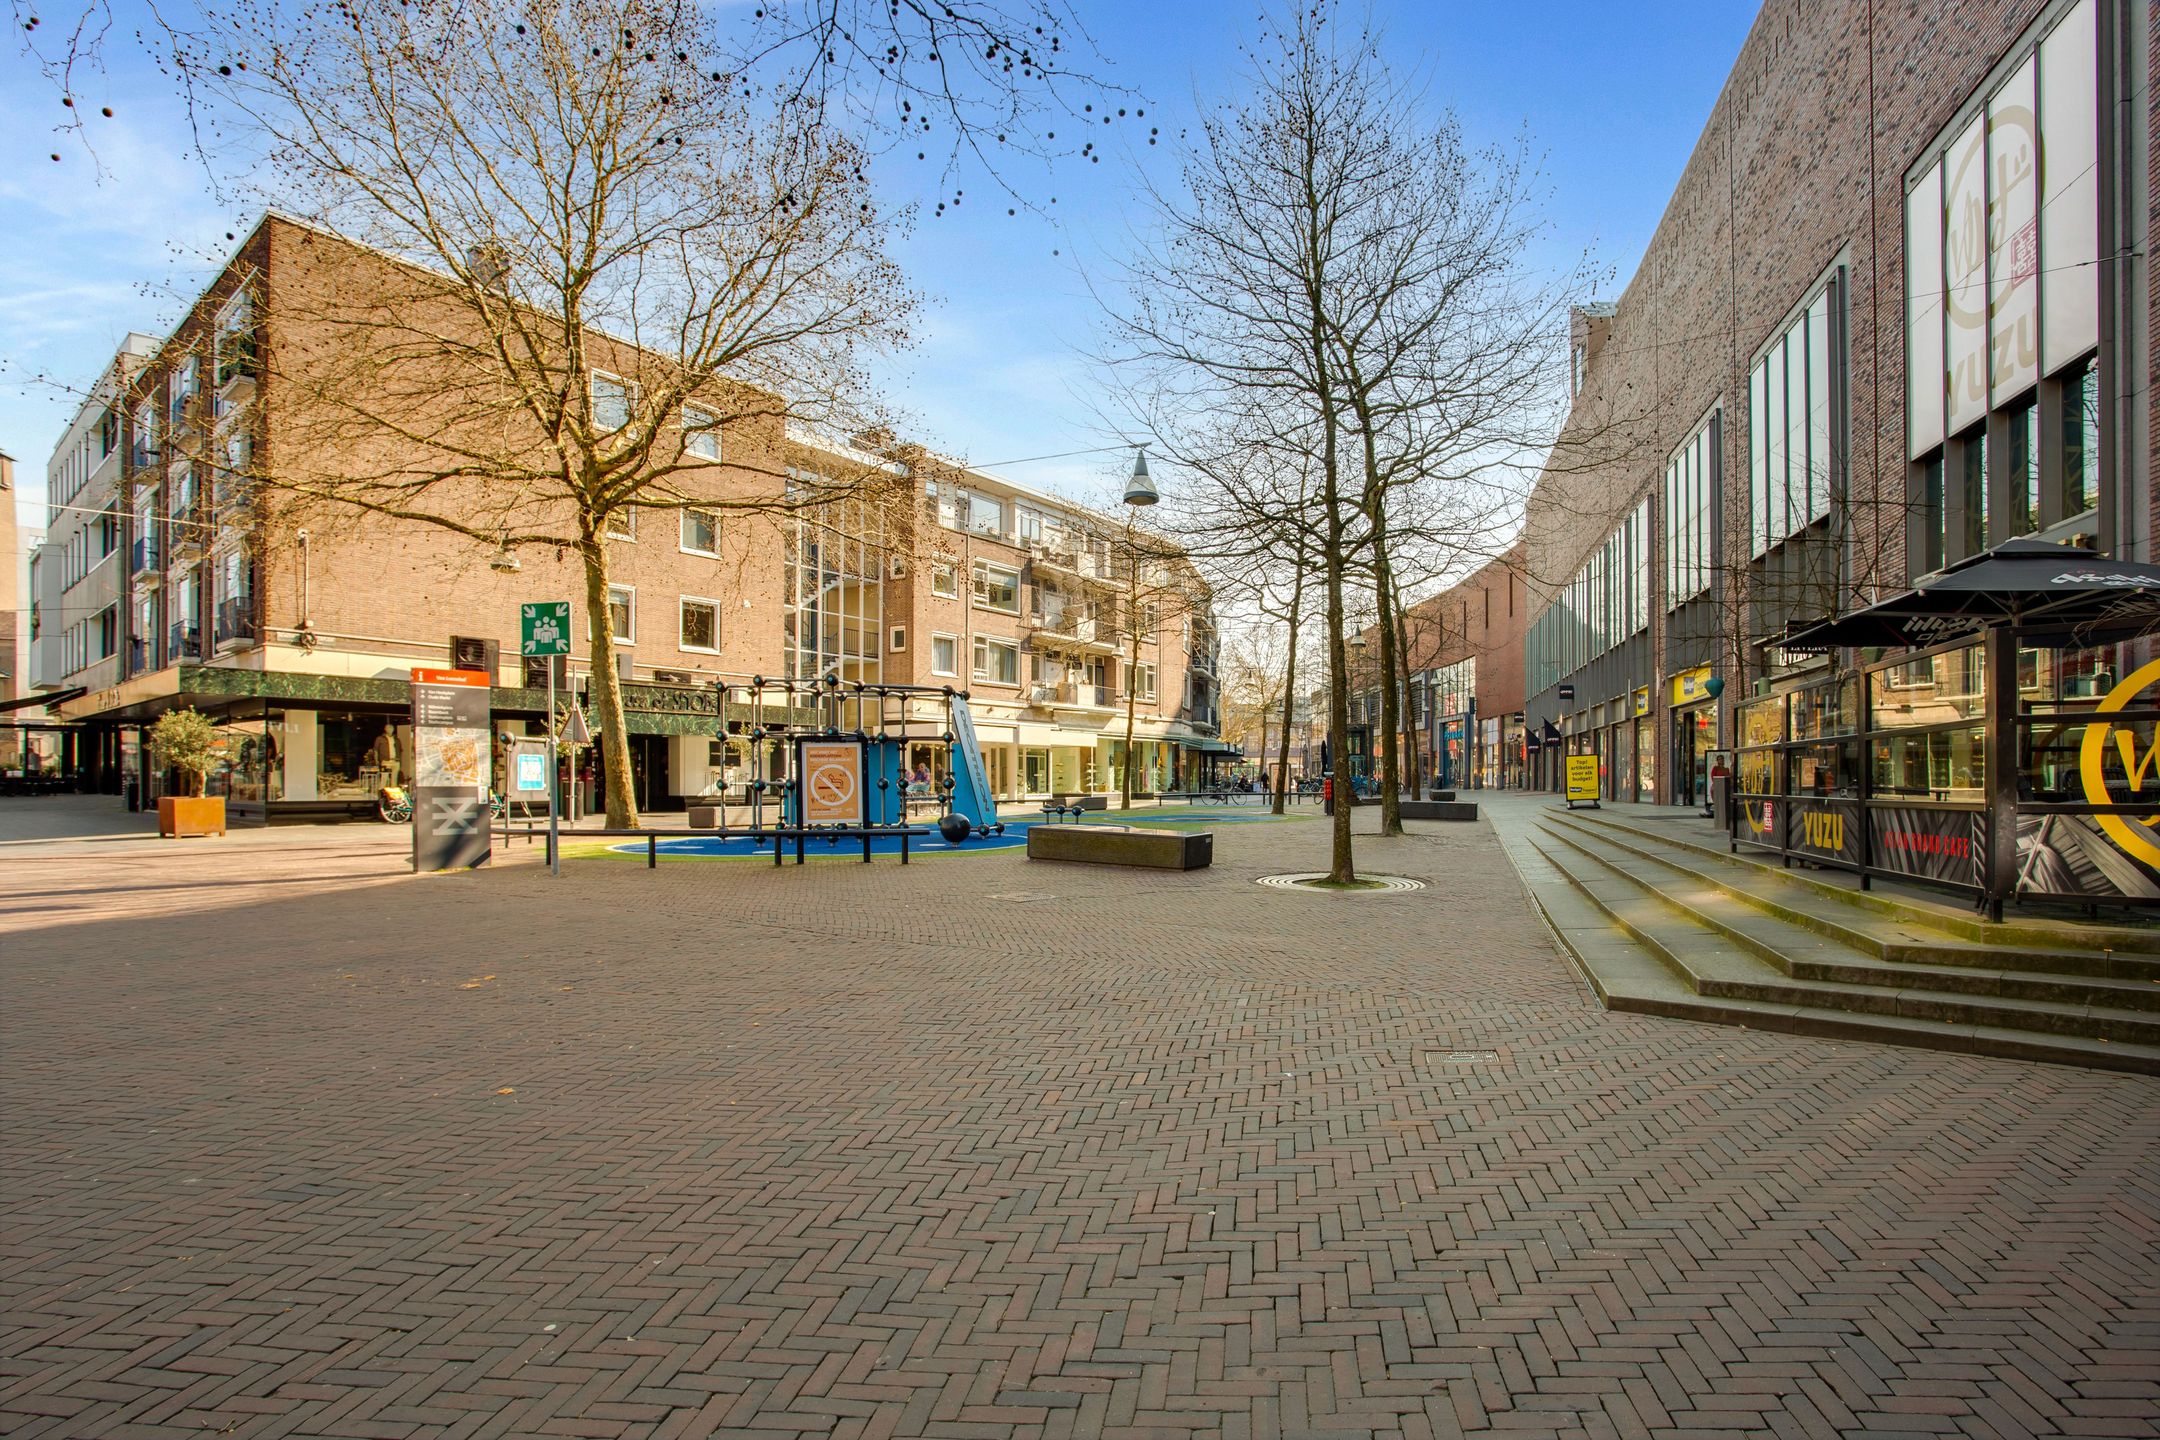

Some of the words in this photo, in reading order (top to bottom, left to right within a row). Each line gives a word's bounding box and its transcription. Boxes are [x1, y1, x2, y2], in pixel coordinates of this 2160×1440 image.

[1947, 305, 2038, 417] YUZU
[960, 709, 990, 813] DECATHLON
[1803, 811, 1844, 851] YUZU
[1884, 831, 1909, 850] ASIAN
[1911, 832, 1940, 855] GRAND
[1943, 835, 1969, 859] CAFE
